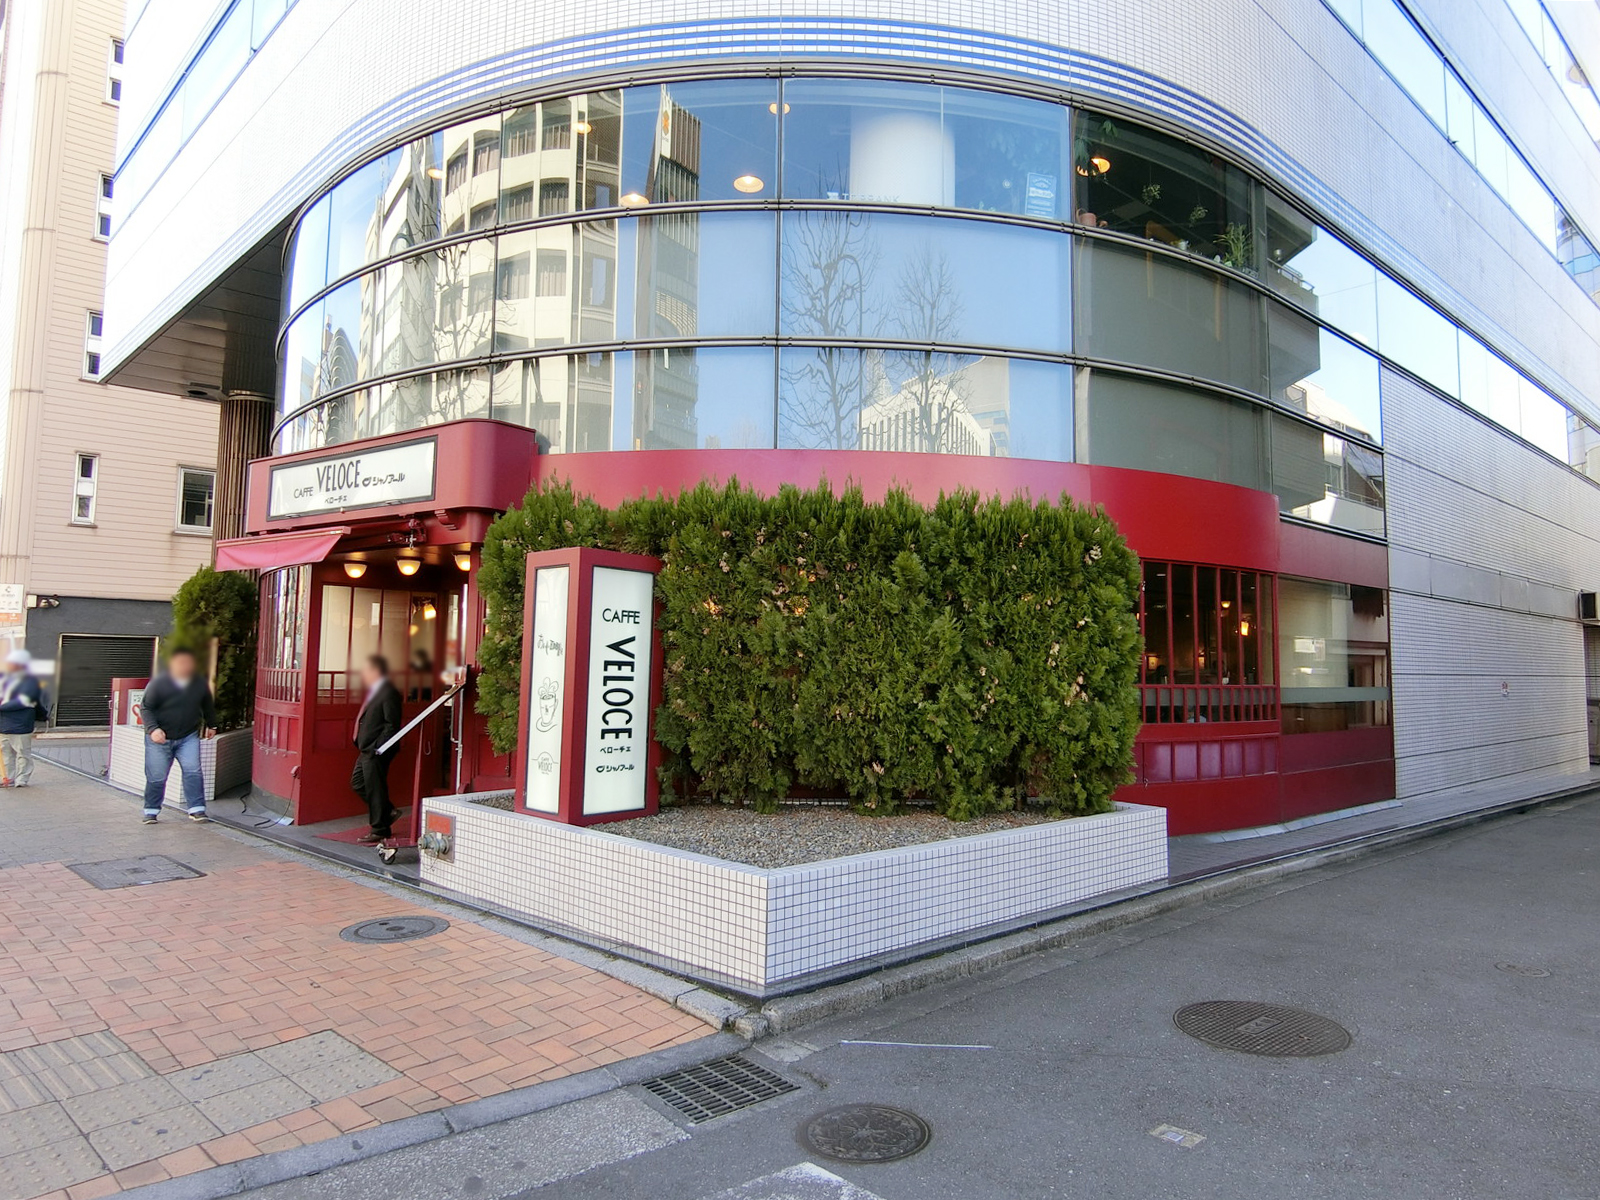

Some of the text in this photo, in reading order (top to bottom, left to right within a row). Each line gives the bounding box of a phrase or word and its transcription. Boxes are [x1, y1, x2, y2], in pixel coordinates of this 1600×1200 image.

[294, 460, 361, 498] CAFFE VELOCE
[602, 608, 640, 624] CAFFE
[601, 636, 635, 739] VELOCE
